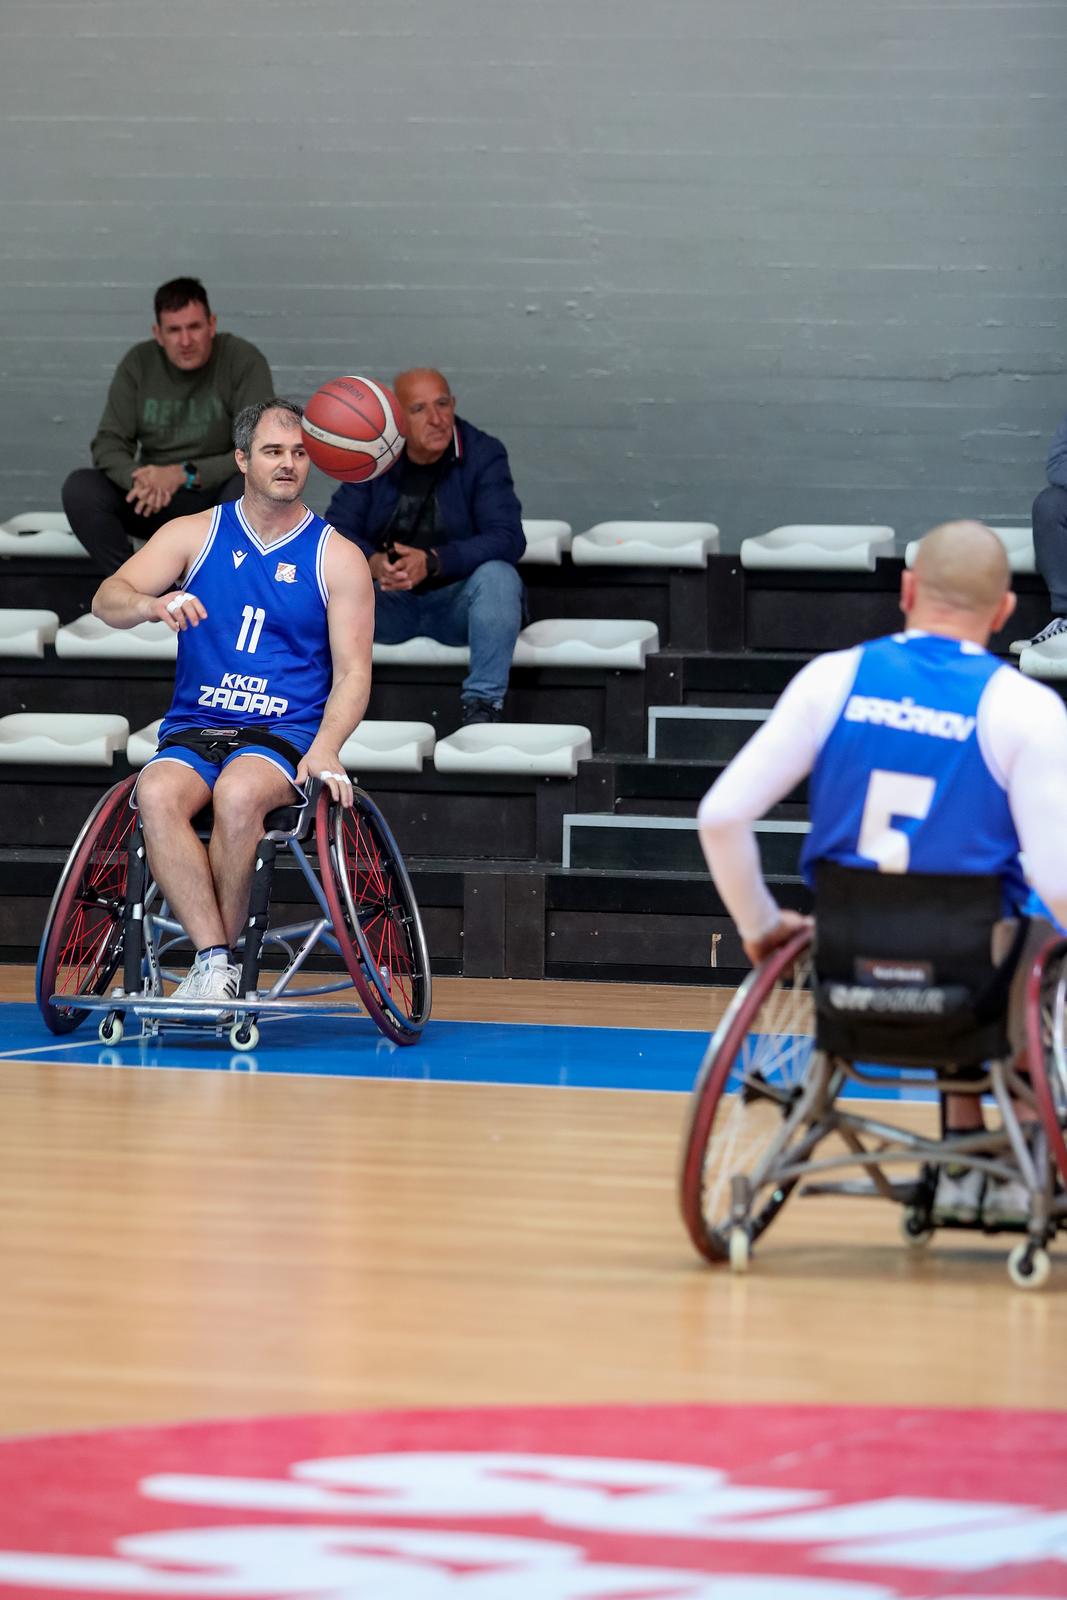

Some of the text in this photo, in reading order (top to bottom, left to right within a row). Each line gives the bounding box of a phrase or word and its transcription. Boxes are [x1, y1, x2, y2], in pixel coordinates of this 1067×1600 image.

[236, 605, 266, 654] 11
[221, 672, 268, 693] KKOI
[198, 685, 288, 717] ZADAR
